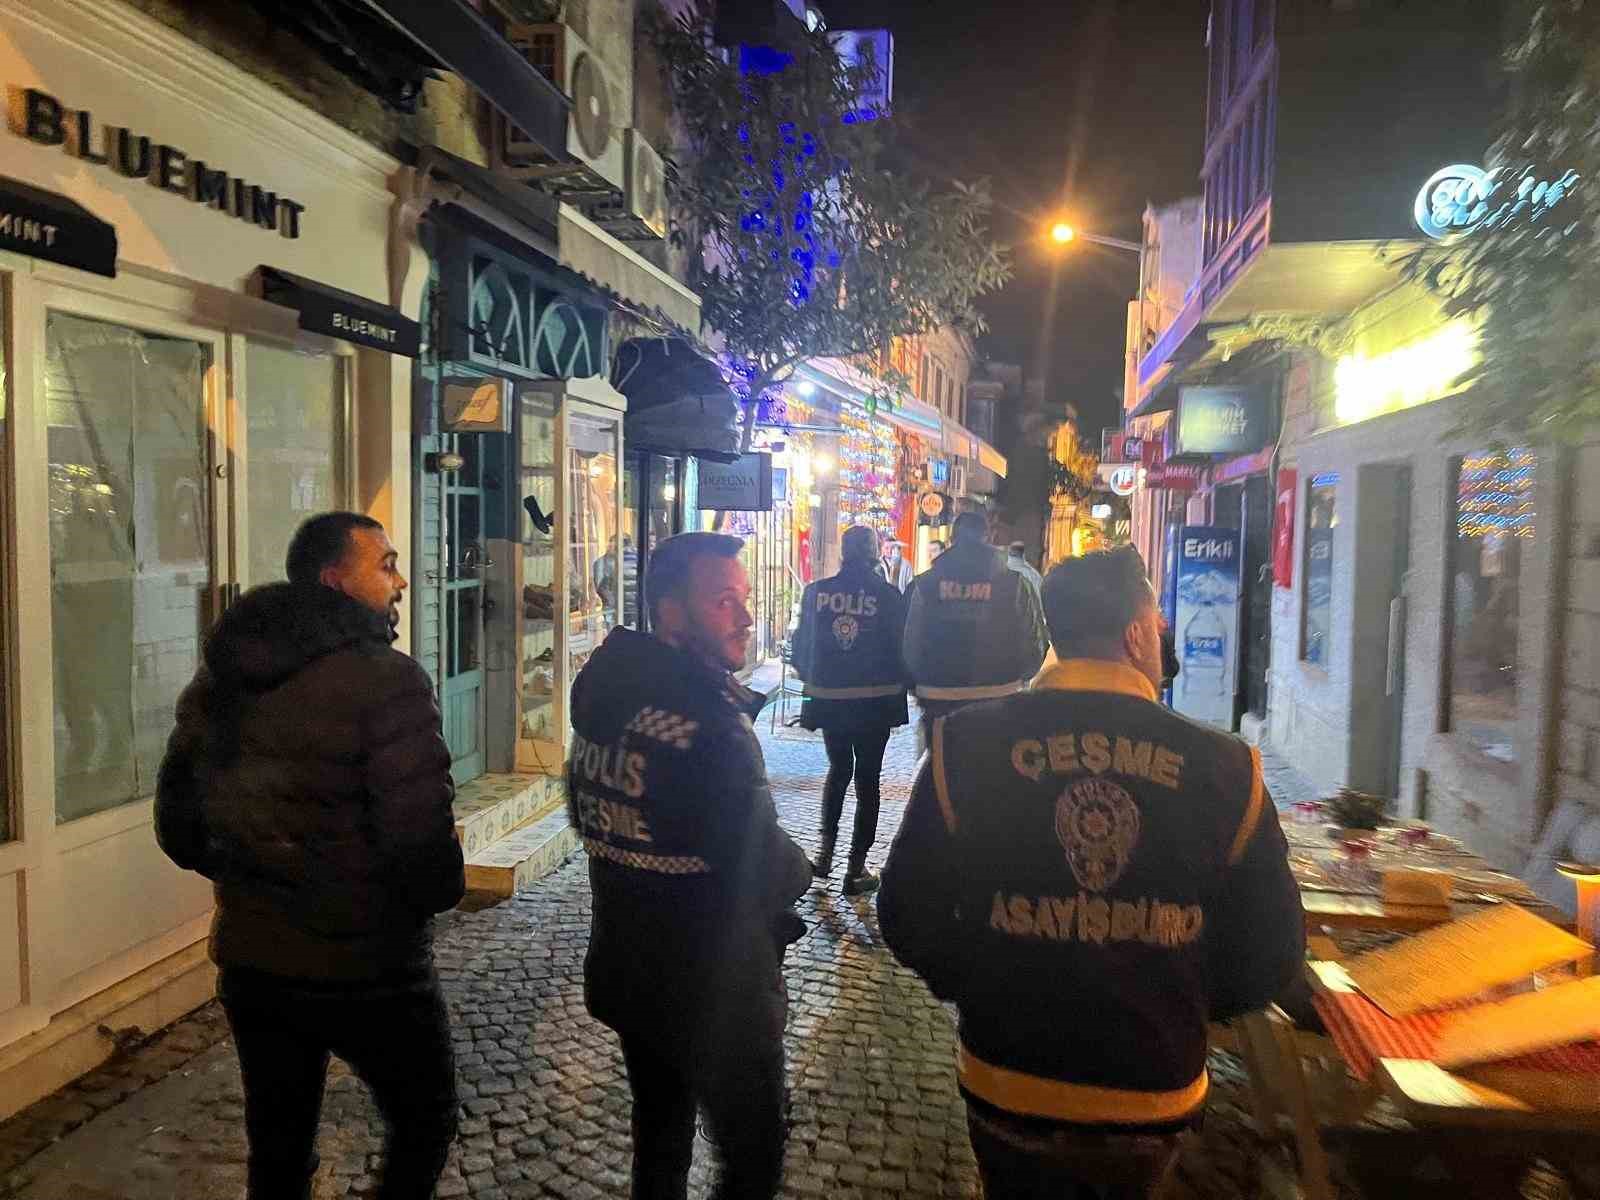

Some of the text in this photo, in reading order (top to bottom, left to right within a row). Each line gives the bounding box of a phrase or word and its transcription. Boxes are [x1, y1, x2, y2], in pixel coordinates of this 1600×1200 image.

[12, 85, 304, 238] BLUEMINT
[333, 312, 396, 342] BLUEMINT
[1184, 537, 1233, 559] Erikli
[816, 589, 878, 617] POLİS
[573, 735, 646, 798] POLİS
